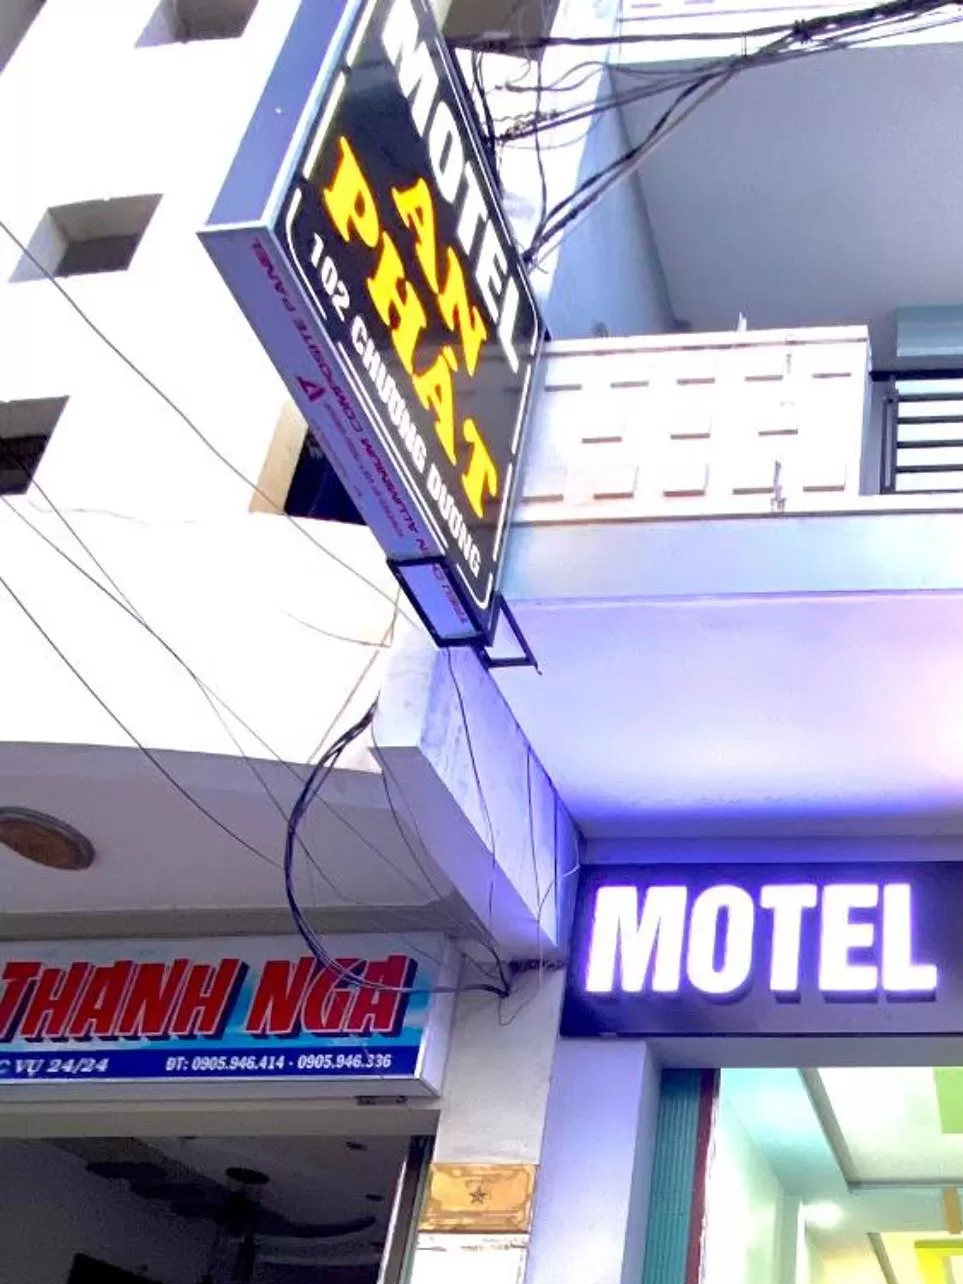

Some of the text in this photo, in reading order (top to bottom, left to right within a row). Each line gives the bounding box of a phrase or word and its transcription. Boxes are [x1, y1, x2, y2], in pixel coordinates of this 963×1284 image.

[381, 0, 519, 374] MOTEL
[252, 237, 297, 312] PANEL
[310, 232, 350, 322] 102
[392, 177, 489, 378] AN
[323, 136, 498, 519] PHÁT
[584, 883, 939, 995] MOTEL
[0, 955, 417, 1041] THANH NGA
[45, 1057, 110, 1075] 24/24
[191, 1055, 286, 1071] 0905.946.414
[297, 1054, 392, 1070] 0905.946.336
